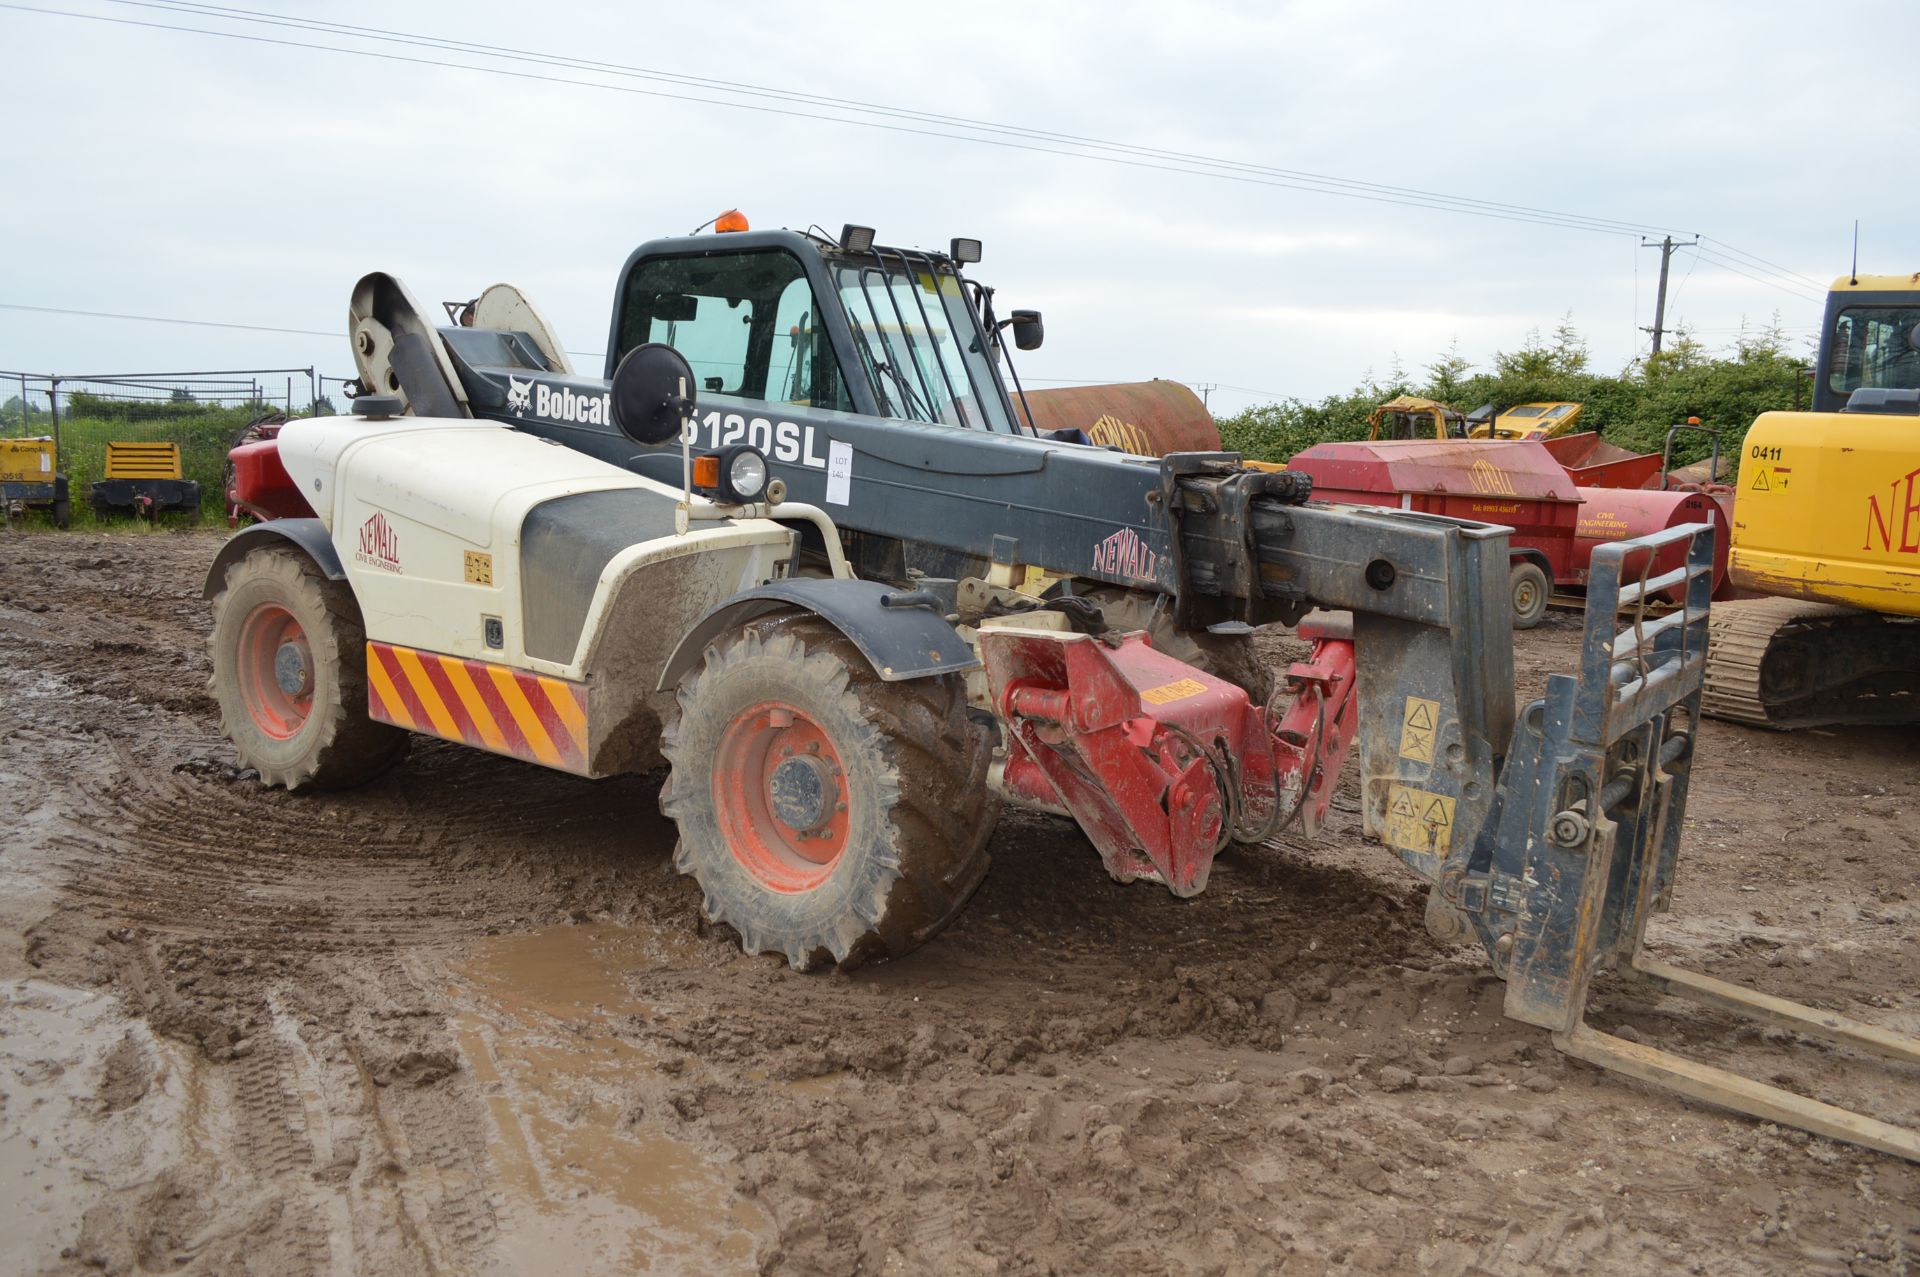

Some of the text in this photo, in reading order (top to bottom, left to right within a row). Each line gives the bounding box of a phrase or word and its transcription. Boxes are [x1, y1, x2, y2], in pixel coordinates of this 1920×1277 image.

[536, 384, 611, 426] Bobcat
[835, 457, 848, 465] LOT
[1751, 446, 1782, 461] 0411
[1467, 459, 1517, 495] NEWALL
[359, 510, 400, 564] NEWALL
[1579, 519, 1628, 528] ENGINEERING
[356, 552, 403, 575] CIVIL ENGINEERING
[1092, 527, 1157, 583] NEWALL
